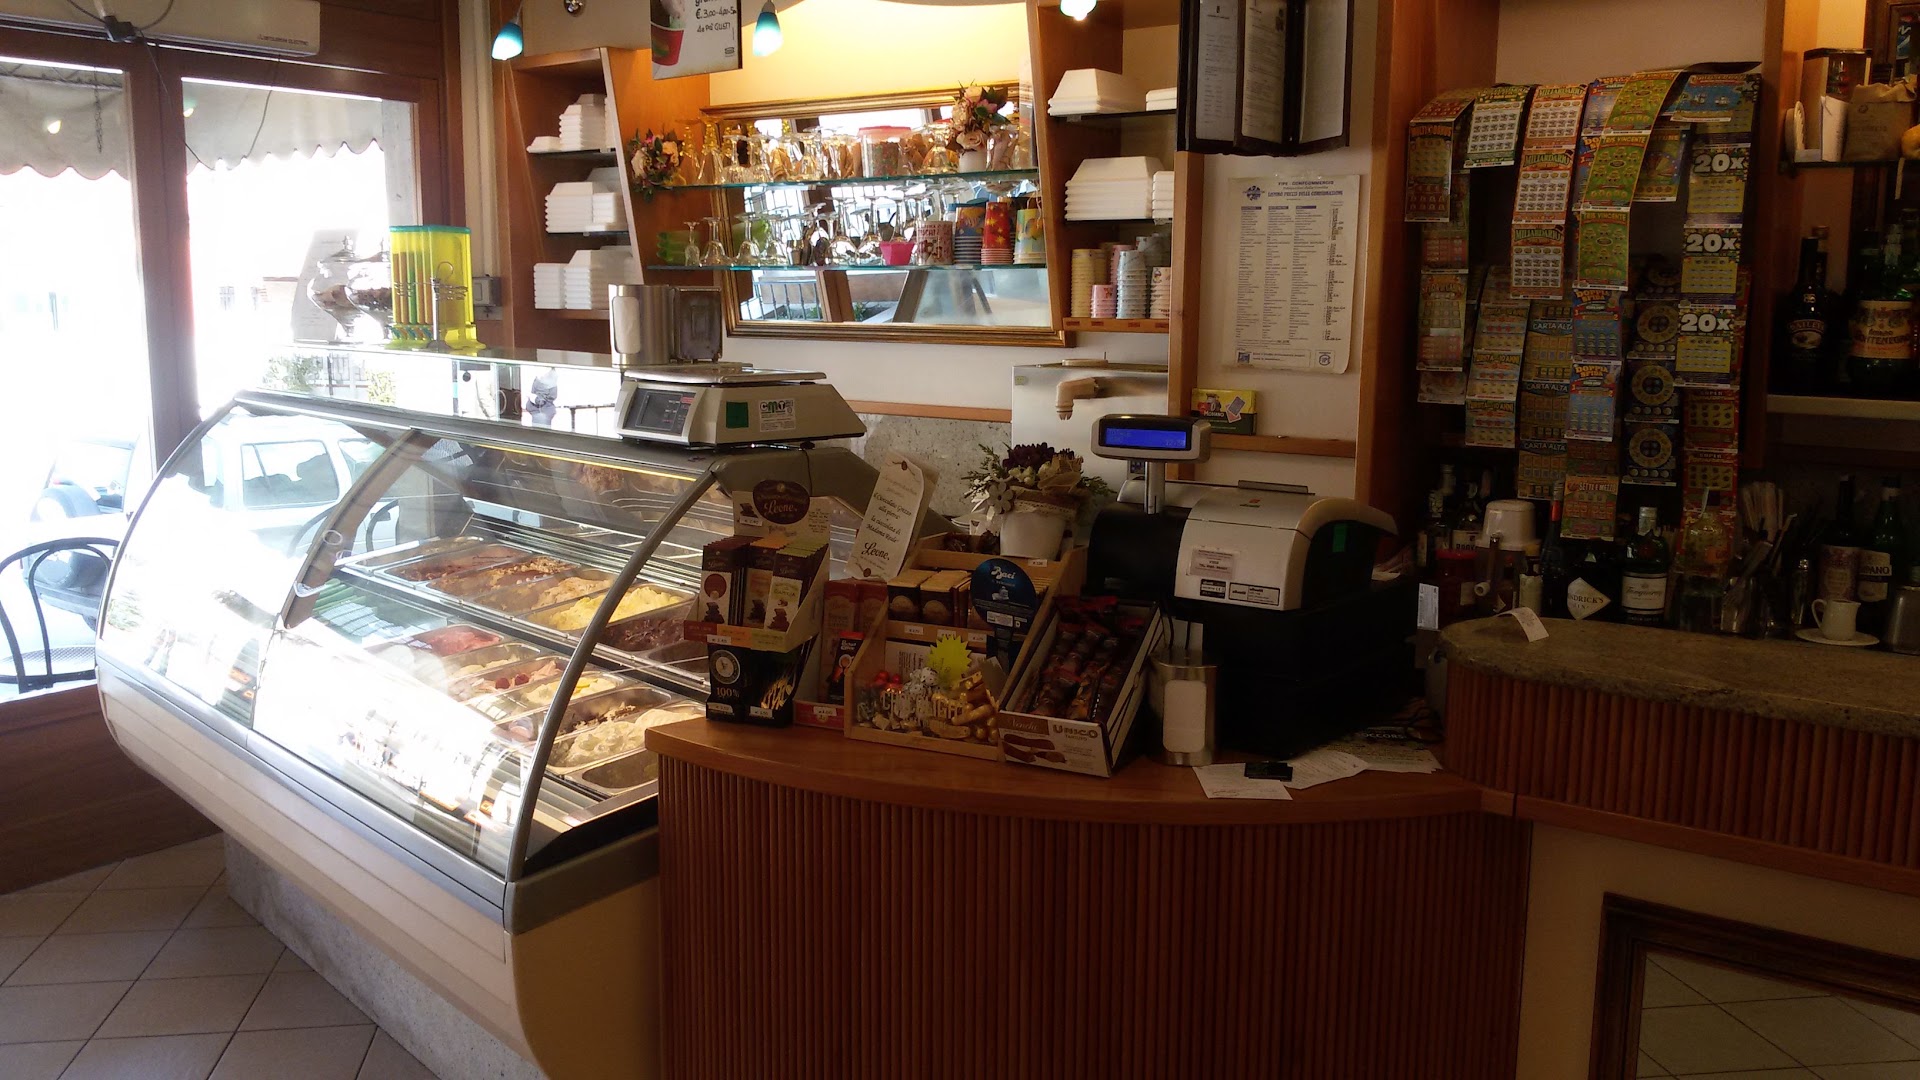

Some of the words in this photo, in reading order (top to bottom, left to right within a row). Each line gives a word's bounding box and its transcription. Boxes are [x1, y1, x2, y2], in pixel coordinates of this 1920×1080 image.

[1686, 232, 1738, 254] 20x
[1681, 312, 1731, 334] 20x
[1052, 724, 1099, 739] UNICO
